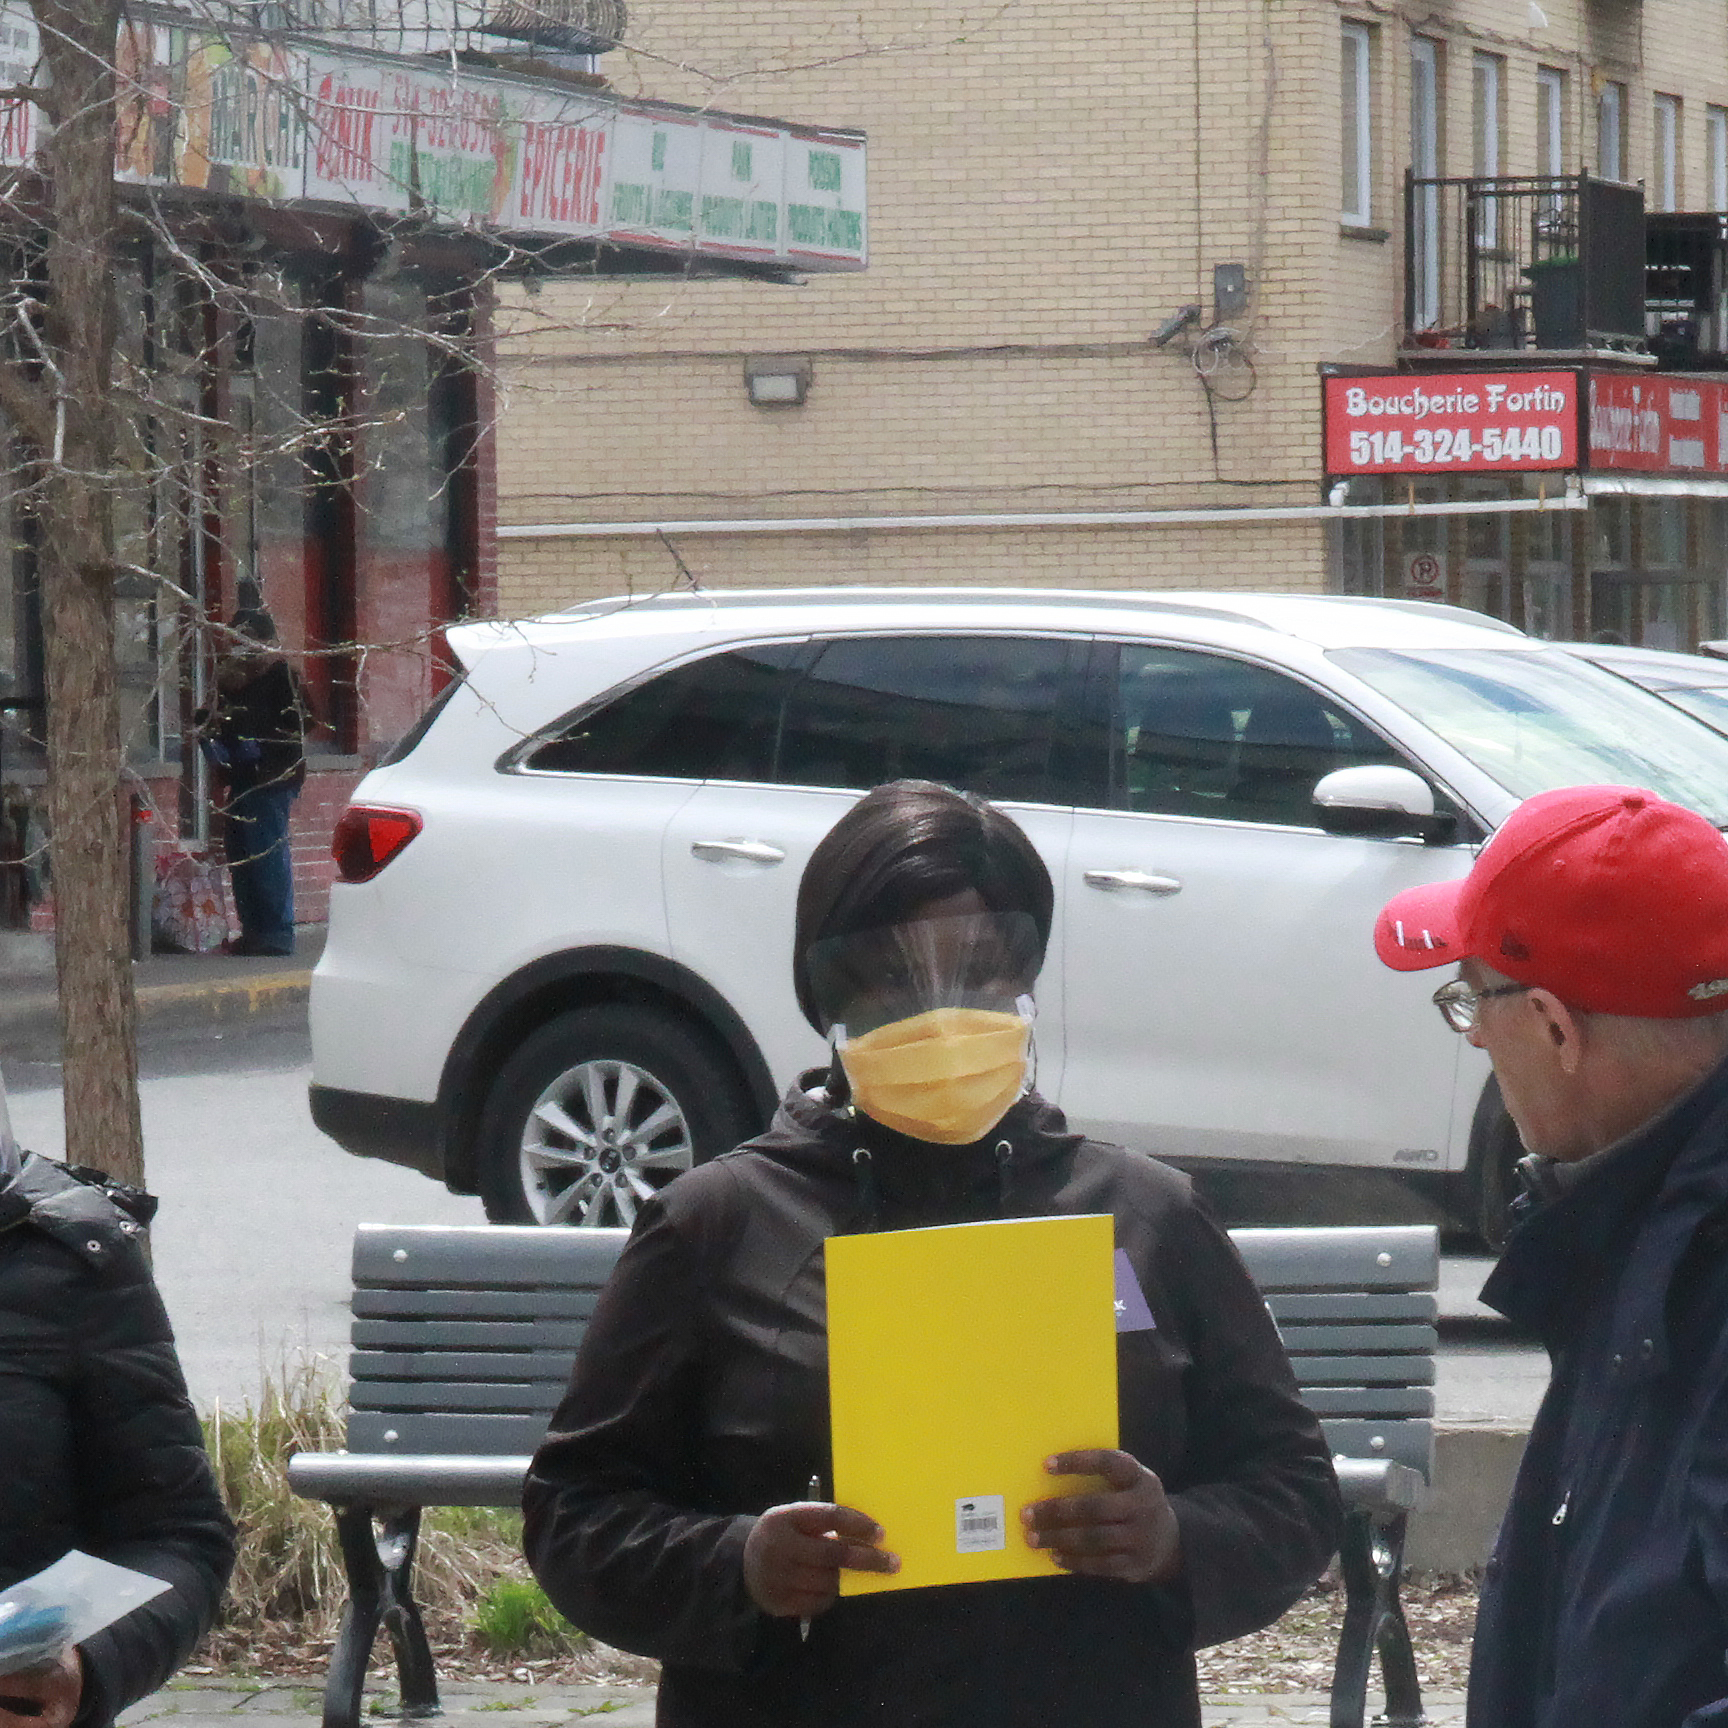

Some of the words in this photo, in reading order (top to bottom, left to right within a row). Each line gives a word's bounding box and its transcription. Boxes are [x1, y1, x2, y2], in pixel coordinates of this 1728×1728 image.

[1345, 386, 1480, 420] Boucherie
[1485, 383, 1566, 414] Fortin
[1349, 425, 1563, 466] 514-324-5440
